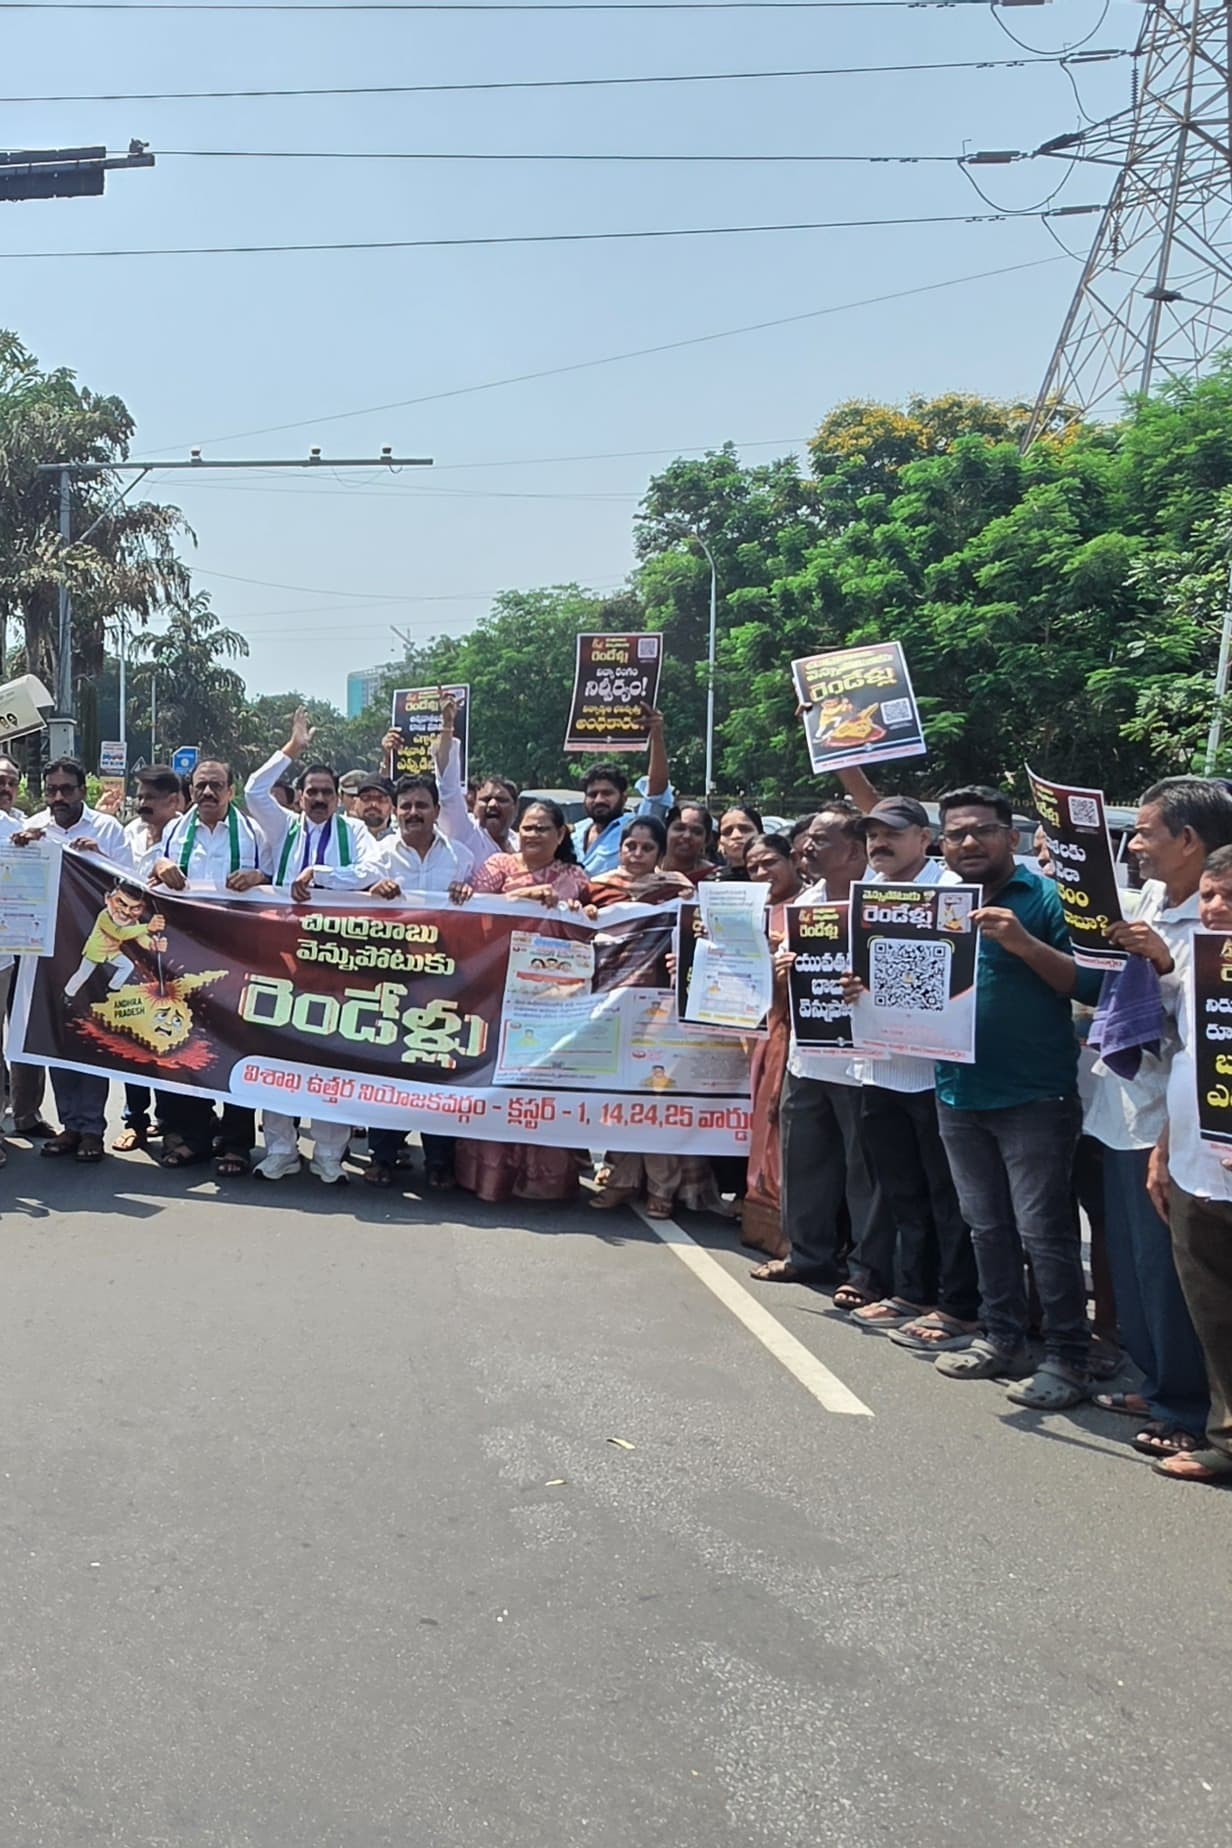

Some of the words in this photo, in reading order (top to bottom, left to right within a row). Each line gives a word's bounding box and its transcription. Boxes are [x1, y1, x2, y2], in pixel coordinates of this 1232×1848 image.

[300, 913, 439, 944] చంద్రబాబు
[296, 939, 455, 976] వెన్నుపోటుకు
[113, 997, 143, 1009] ANDHRA
[114, 1007, 145, 1019] PRADESH
[239, 973, 488, 1069] రెండేళ్లు
[243, 1064, 301, 1094] విశాఖ
[358, 1084, 487, 1124] నియోజకవర్గం
[578, 1102, 590, 1125] 1,
[601, 1103, 693, 1128] 14,24,25
[698, 1107, 752, 1141] వార్డు
